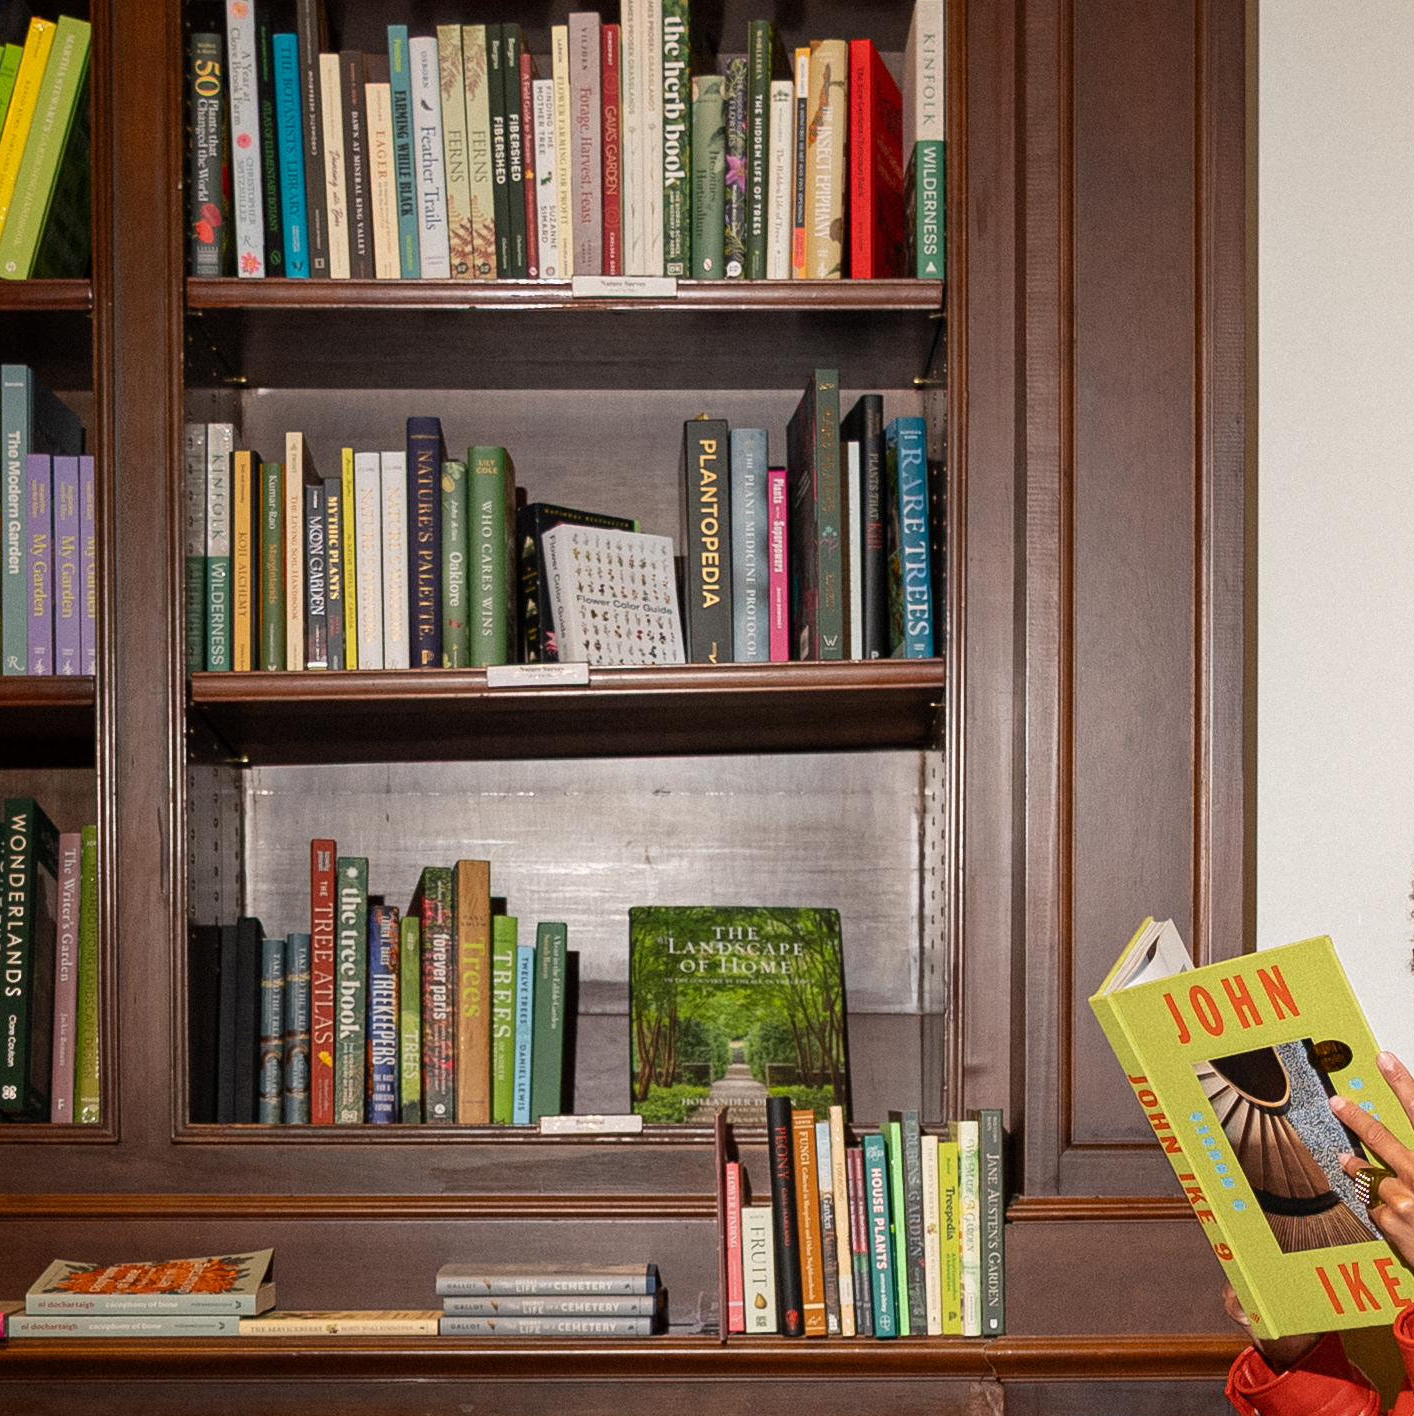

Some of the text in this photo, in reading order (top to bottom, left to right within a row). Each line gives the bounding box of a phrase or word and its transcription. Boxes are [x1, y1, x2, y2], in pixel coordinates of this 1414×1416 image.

[196, 60, 219, 96] 50
[662, 16, 684, 187] the herb book
[197, 100, 209, 201] Changed the World
[207, 100, 219, 157] Plants that
[394, 90, 413, 217] FARMING WHILE BLACK
[472, 130, 488, 183] FERNS
[509, 114, 521, 182] FIBERSHED
[923, 34, 937, 254] KINFOLK WILDERNESS
[419, 126, 441, 230] Feather Trails
[8, 431, 22, 574] The Modern Garden
[417, 450, 434, 641] NATURE'S PALETTE.
[699, 439, 719, 608] PLANTOPEDIA
[901, 448, 929, 636] RARE TREES
[31, 534, 47, 616] My Garden
[449, 552, 462, 607] Oaklore
[482, 501, 493, 636] WHO CARES WINS
[5, 814, 26, 997] WONDERLANDS
[669, 937, 803, 956] LANDSCAPE
[711, 926, 760, 940] THE
[314, 903, 333, 1044] TREE ATLAS
[339, 888, 361, 1039] the tree book
[462, 937, 486, 1018] Trees
[493, 951, 512, 1038] TREES
[680, 959, 791, 974] OF HOME
[1163, 964, 1300, 1044] JOHN
[372, 974, 395, 1066] TREEKEEPERS
[775, 1126, 789, 1180] PEONY
[1127, 1074, 1234, 1262] JOHN IKE 9
[751, 1227, 767, 1287] FRUIT
[871, 1168, 887, 1269] HOUSE PLANTS
[944, 1187, 955, 1240] Treepedia
[986, 1154, 1000, 1307] JANE AUSTEN'S GARDEN
[554, 1281, 614, 1291] CEMETERY
[1316, 1257, 1412, 1315] IKE
